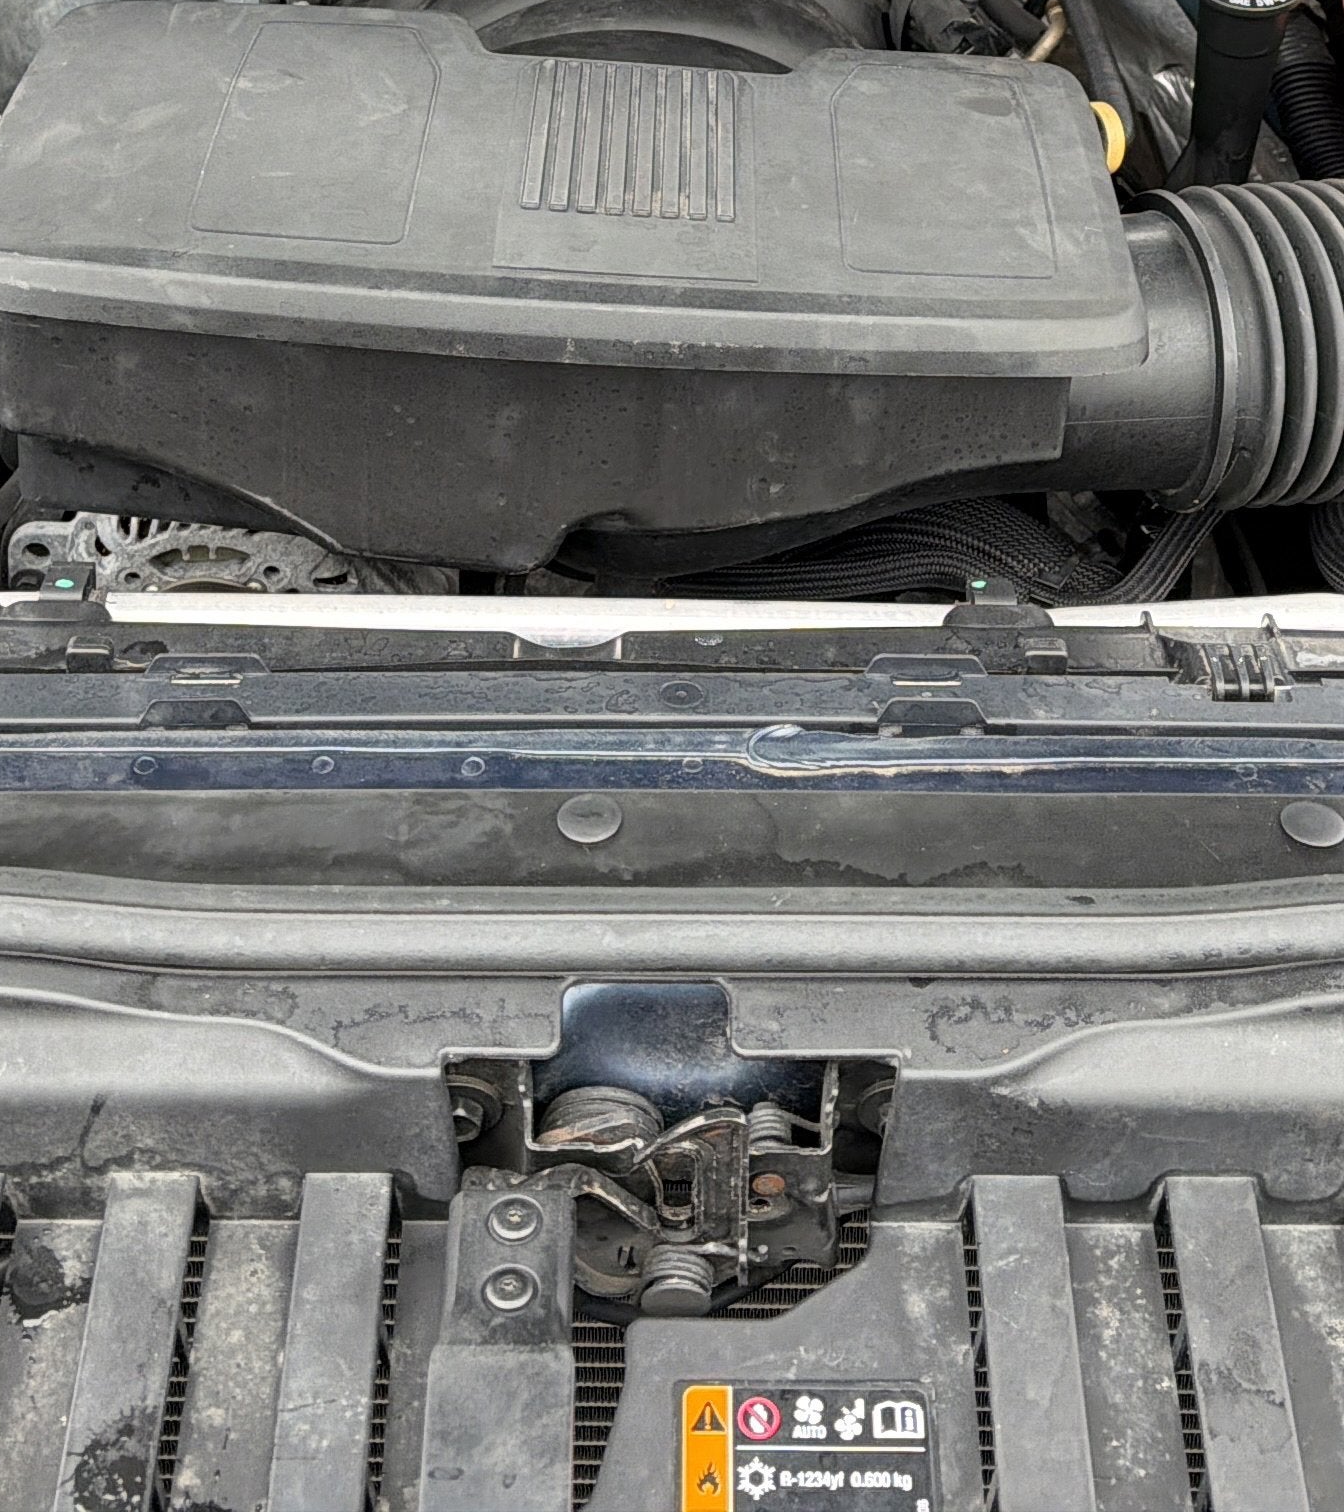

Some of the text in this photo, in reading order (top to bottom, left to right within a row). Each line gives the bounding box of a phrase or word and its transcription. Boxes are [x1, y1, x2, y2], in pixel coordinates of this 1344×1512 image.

[792, 1425, 827, 1439] AUTO
[780, 1470, 845, 1490] R-1234yf
[893, 1471, 912, 1491] kg
